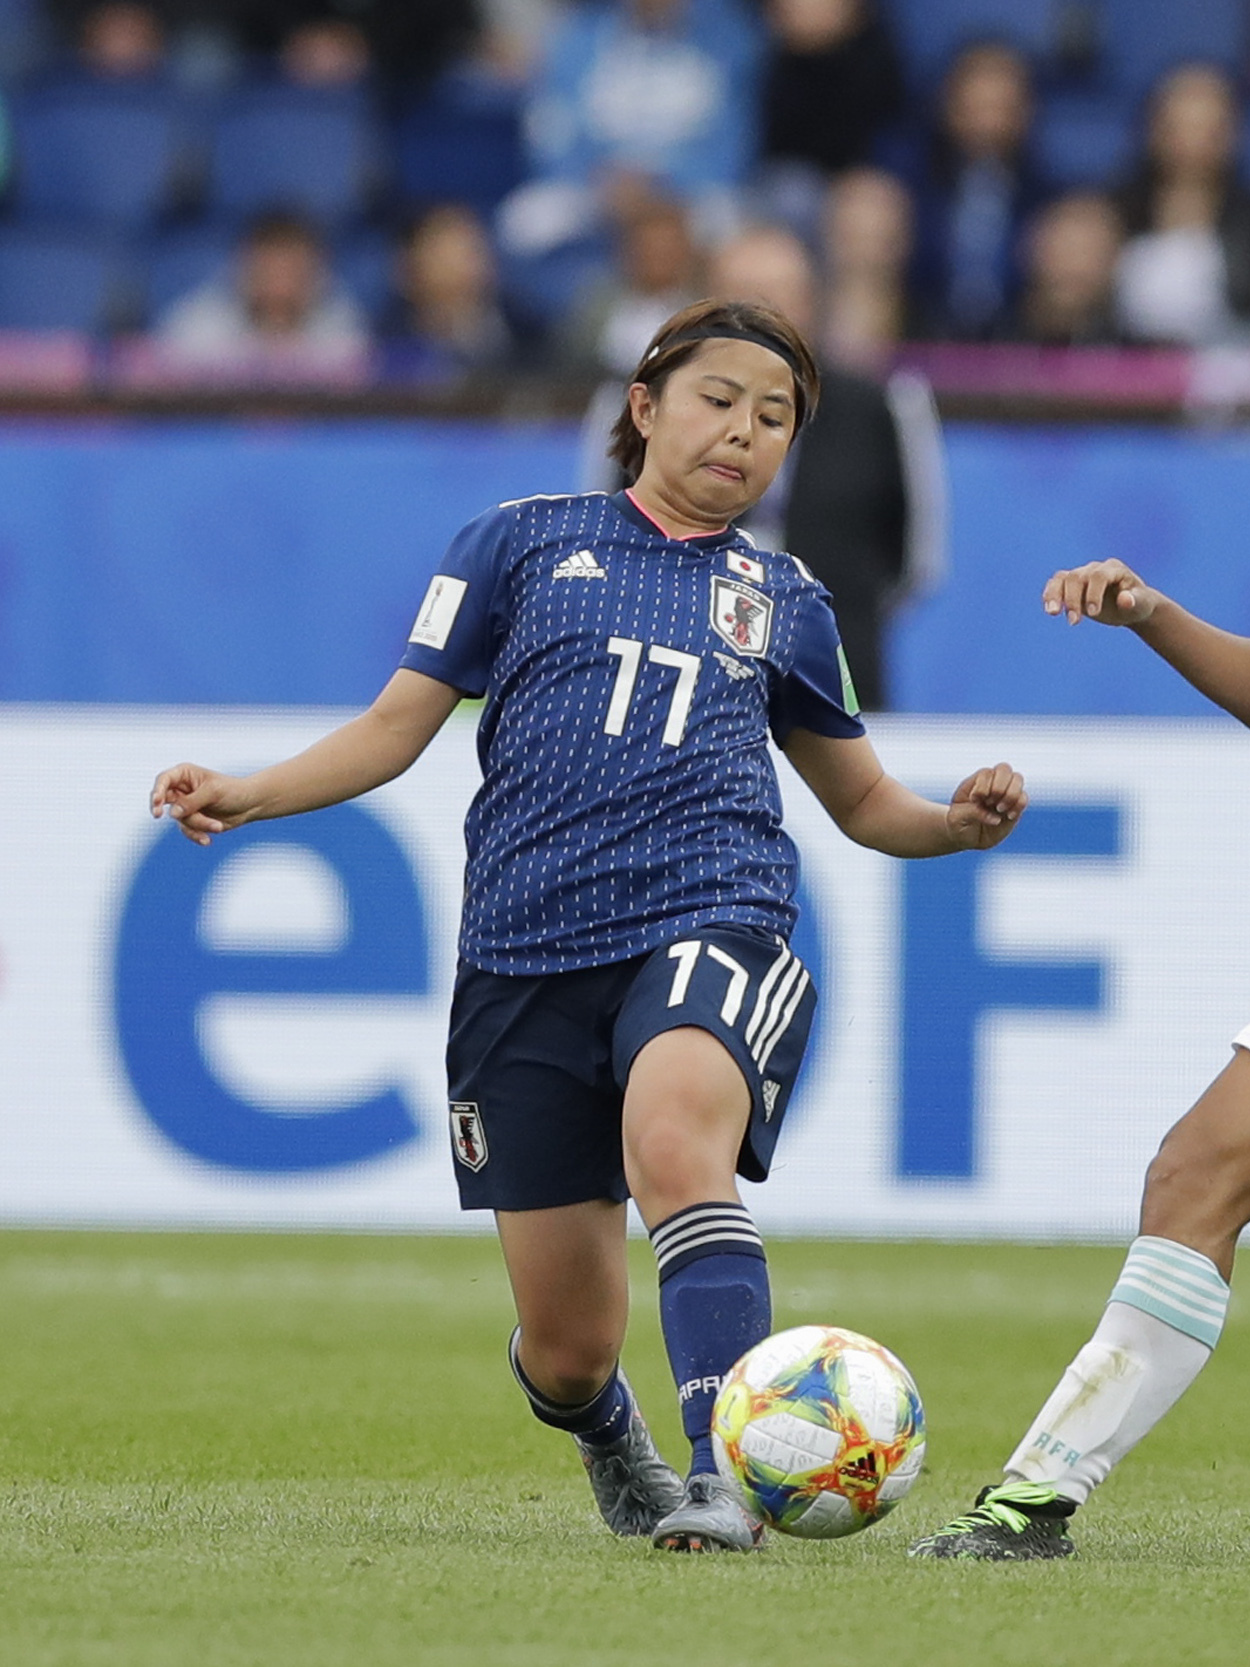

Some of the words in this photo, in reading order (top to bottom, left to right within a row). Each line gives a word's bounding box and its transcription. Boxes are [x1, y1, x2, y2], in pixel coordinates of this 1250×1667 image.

[552, 566, 606, 579] adidas
[603, 635, 702, 748] 17
[666, 939, 750, 1029] 17
[1032, 1431, 1082, 1468] AFA
